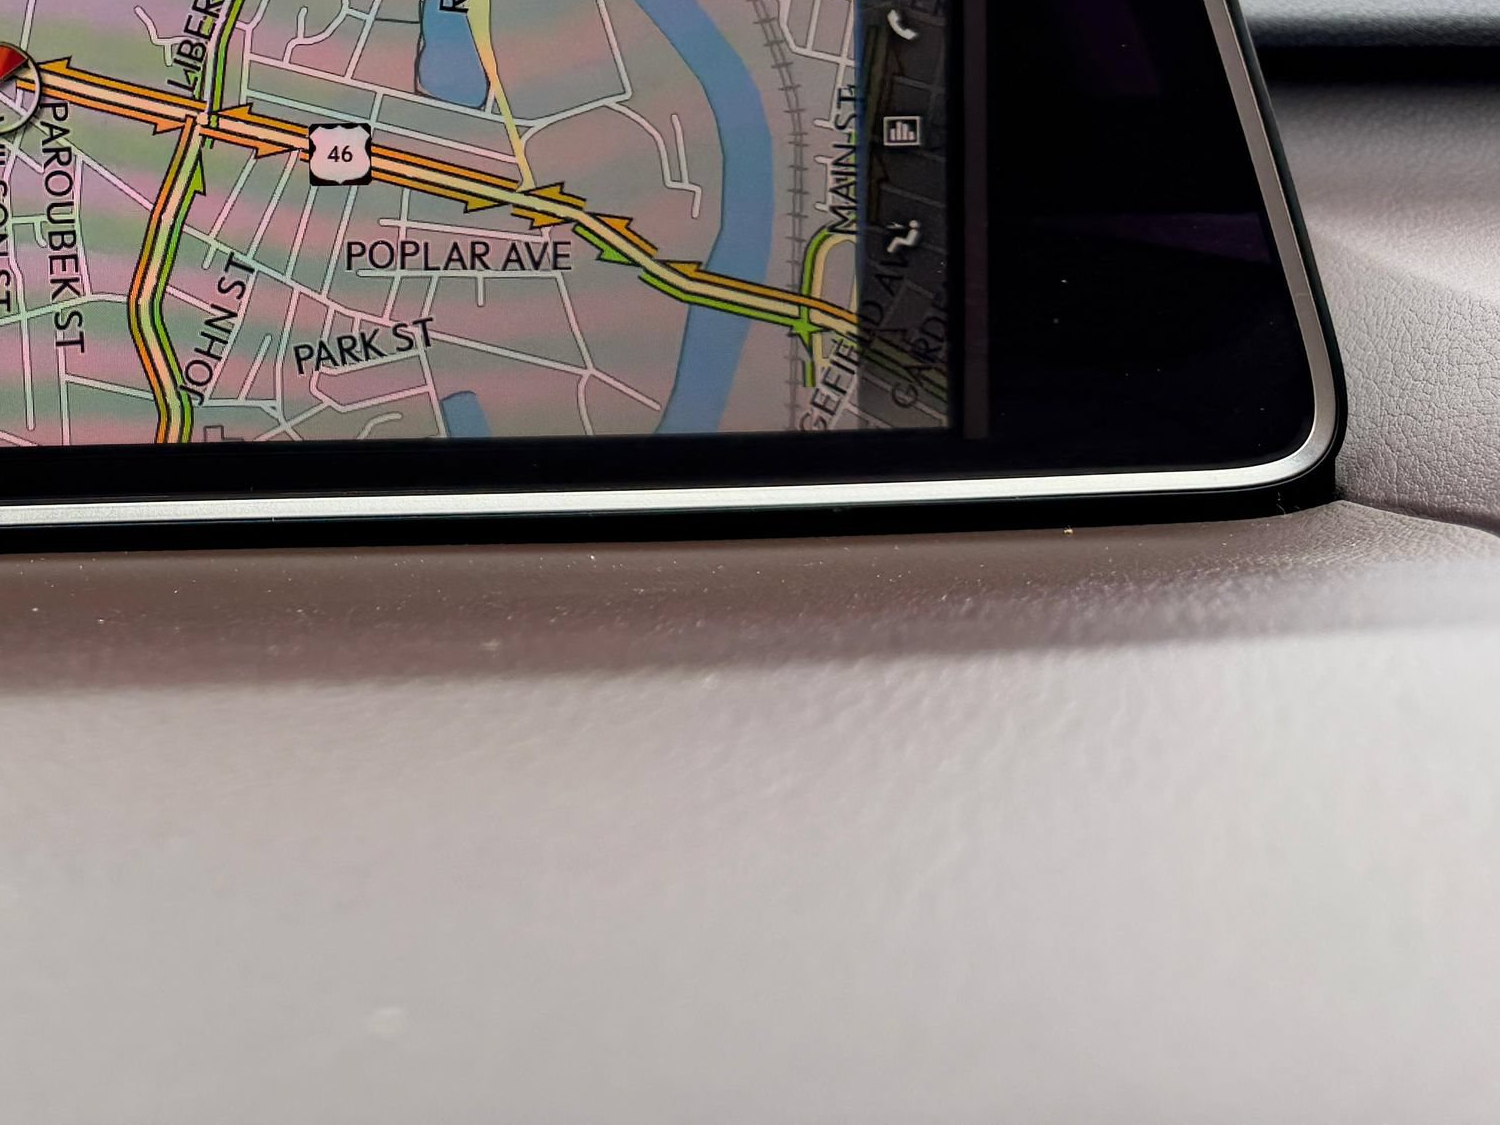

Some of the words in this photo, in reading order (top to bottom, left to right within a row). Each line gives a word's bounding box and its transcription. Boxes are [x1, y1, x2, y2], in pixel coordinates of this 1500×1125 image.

[834, 87, 865, 131] ST
[327, 145, 354, 164] 46
[39, 101, 82, 301] PAROUBEK
[828, 144, 860, 236] MAIN
[345, 239, 490, 273] POPLAR
[502, 240, 573, 272] AVE
[53, 309, 86, 354] ST
[180, 302, 239, 406] JOHN
[217, 251, 257, 300] ST
[293, 328, 385, 376] PARK
[392, 316, 434, 354] ST
